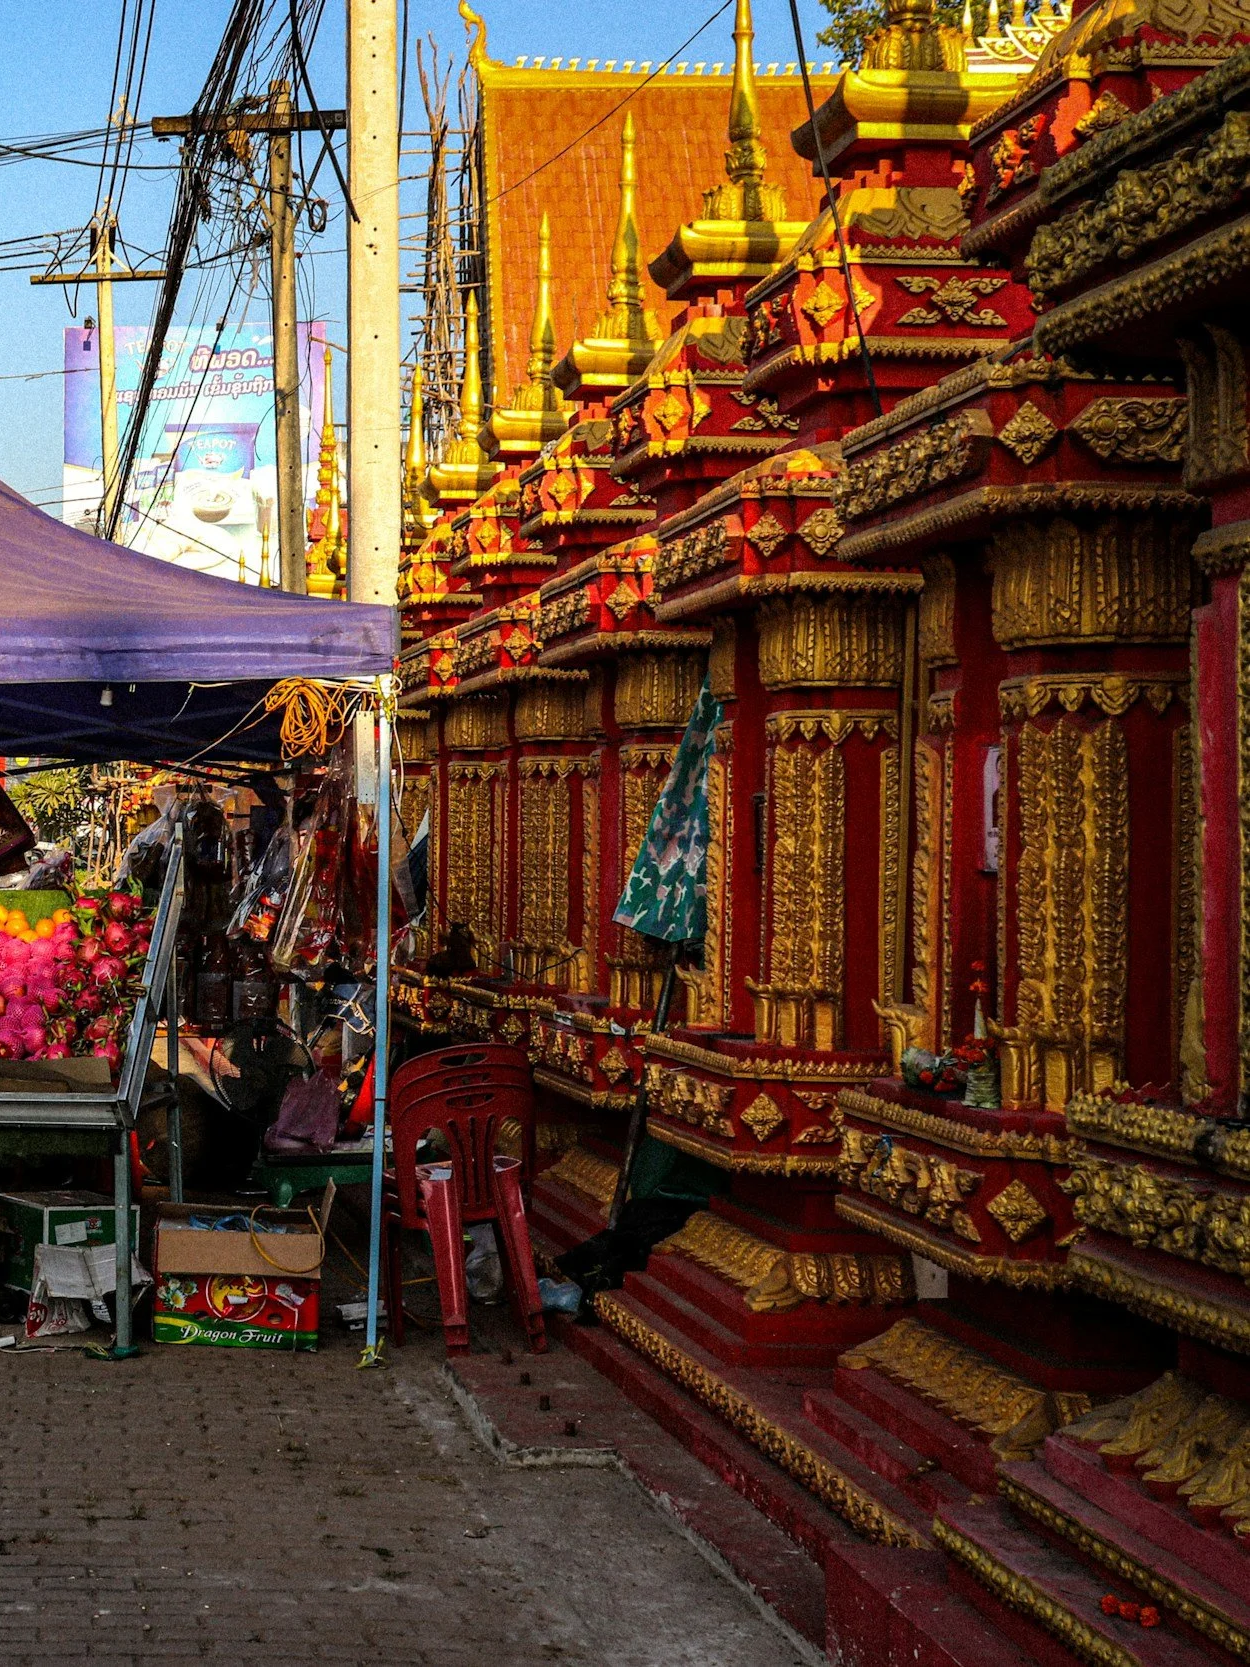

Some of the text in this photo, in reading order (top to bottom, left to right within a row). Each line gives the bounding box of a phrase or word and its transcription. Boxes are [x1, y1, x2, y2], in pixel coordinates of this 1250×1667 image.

[125, 340, 189, 355] TEOT
[188, 438, 236, 451] TEAPOT
[180, 1325, 284, 1343] Dragon Fruit
